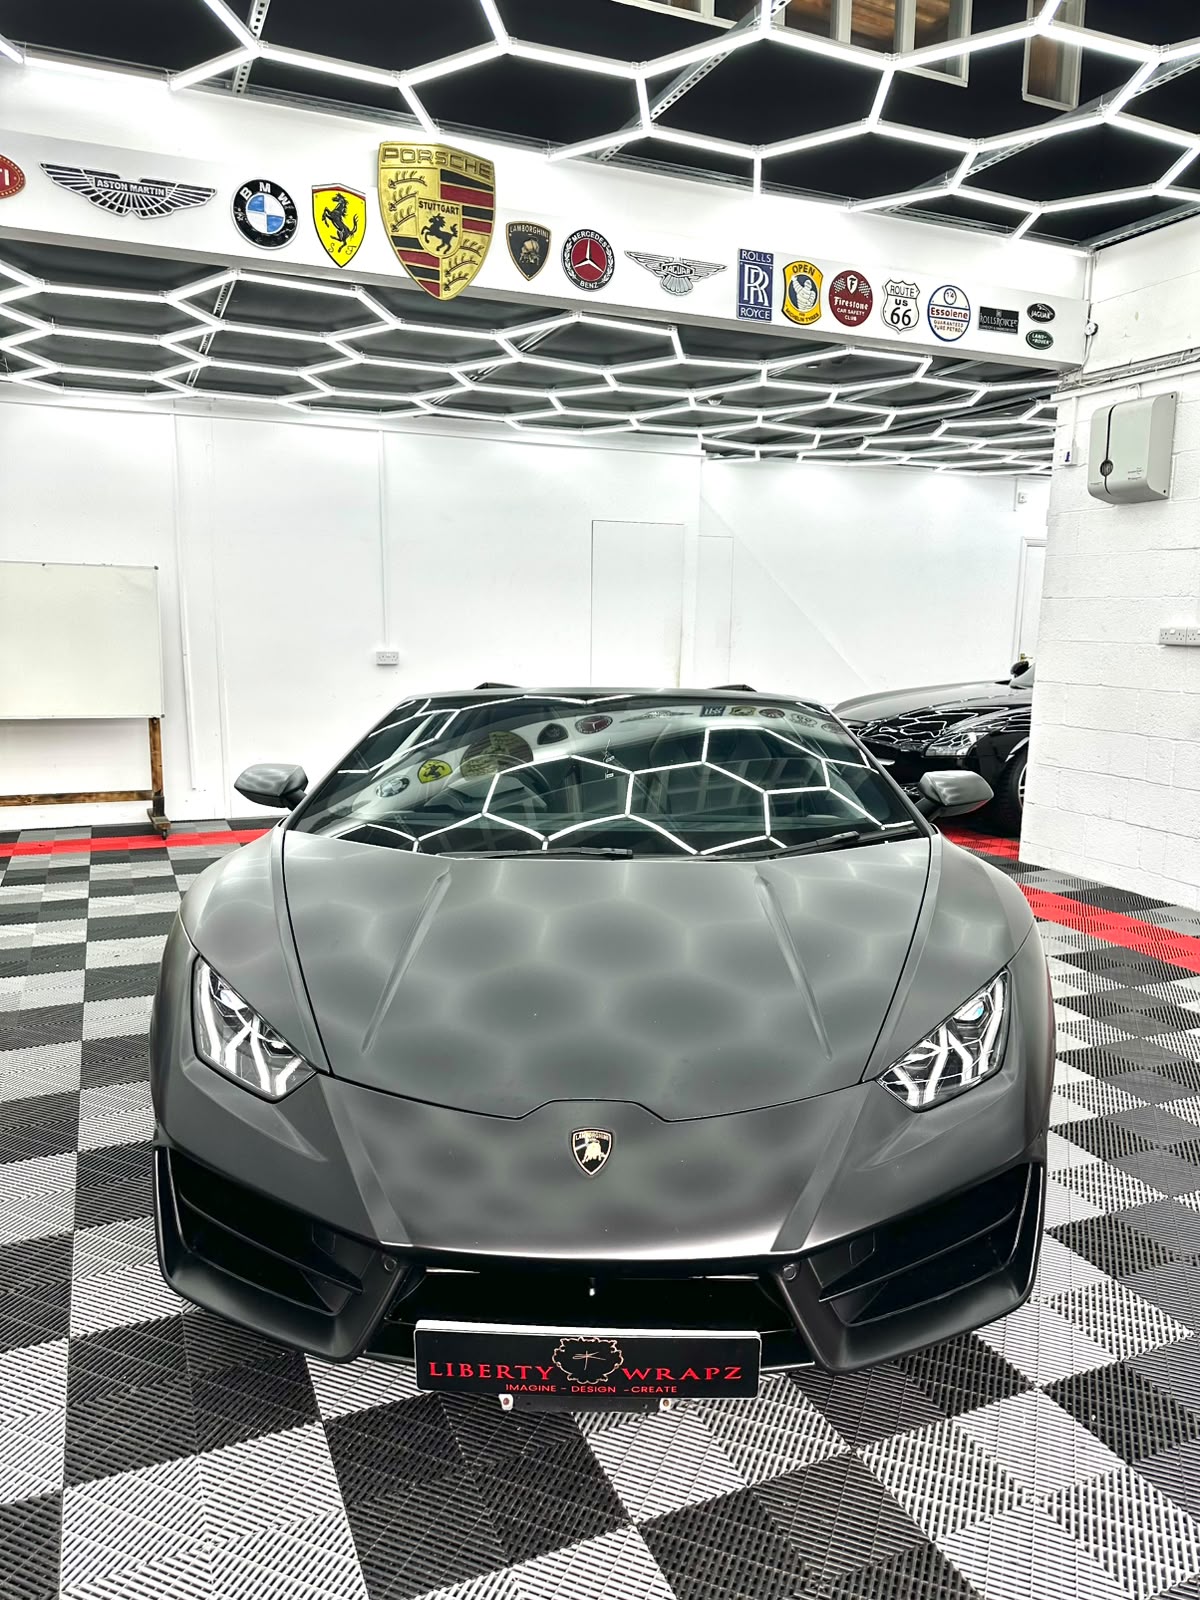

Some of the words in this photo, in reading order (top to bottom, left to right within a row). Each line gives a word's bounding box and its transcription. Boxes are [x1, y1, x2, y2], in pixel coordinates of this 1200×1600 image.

[381, 147, 493, 179] PORSCHE
[96, 179, 128, 192] ASTON
[129, 184, 166, 197] MARTIN
[239, 181, 291, 207] BMW
[417, 200, 460, 215] STUTTGART
[509, 225, 549, 239] LAMBORGHINI
[571, 230, 608, 249] MERCEDES
[741, 250, 772, 263] ROLLS
[663, 264, 692, 275] JAGUAR
[791, 263, 816, 277] OPEN
[578, 280, 599, 289] BENZ
[889, 284, 915, 298] ROUTE
[833, 296, 869, 311] Firestone
[894, 299, 909, 307] US
[740, 307, 771, 320] ROYCE
[847, 309, 865, 317] SAFETY
[890, 307, 912, 326] 66
[930, 306, 969, 320] Essolene
[428, 1361, 554, 1381] LIBERTY
[621, 1366, 744, 1382] WRAPZ
[505, 1383, 557, 1394] IMAGINE
[571, 1385, 617, 1394] DESIGN
